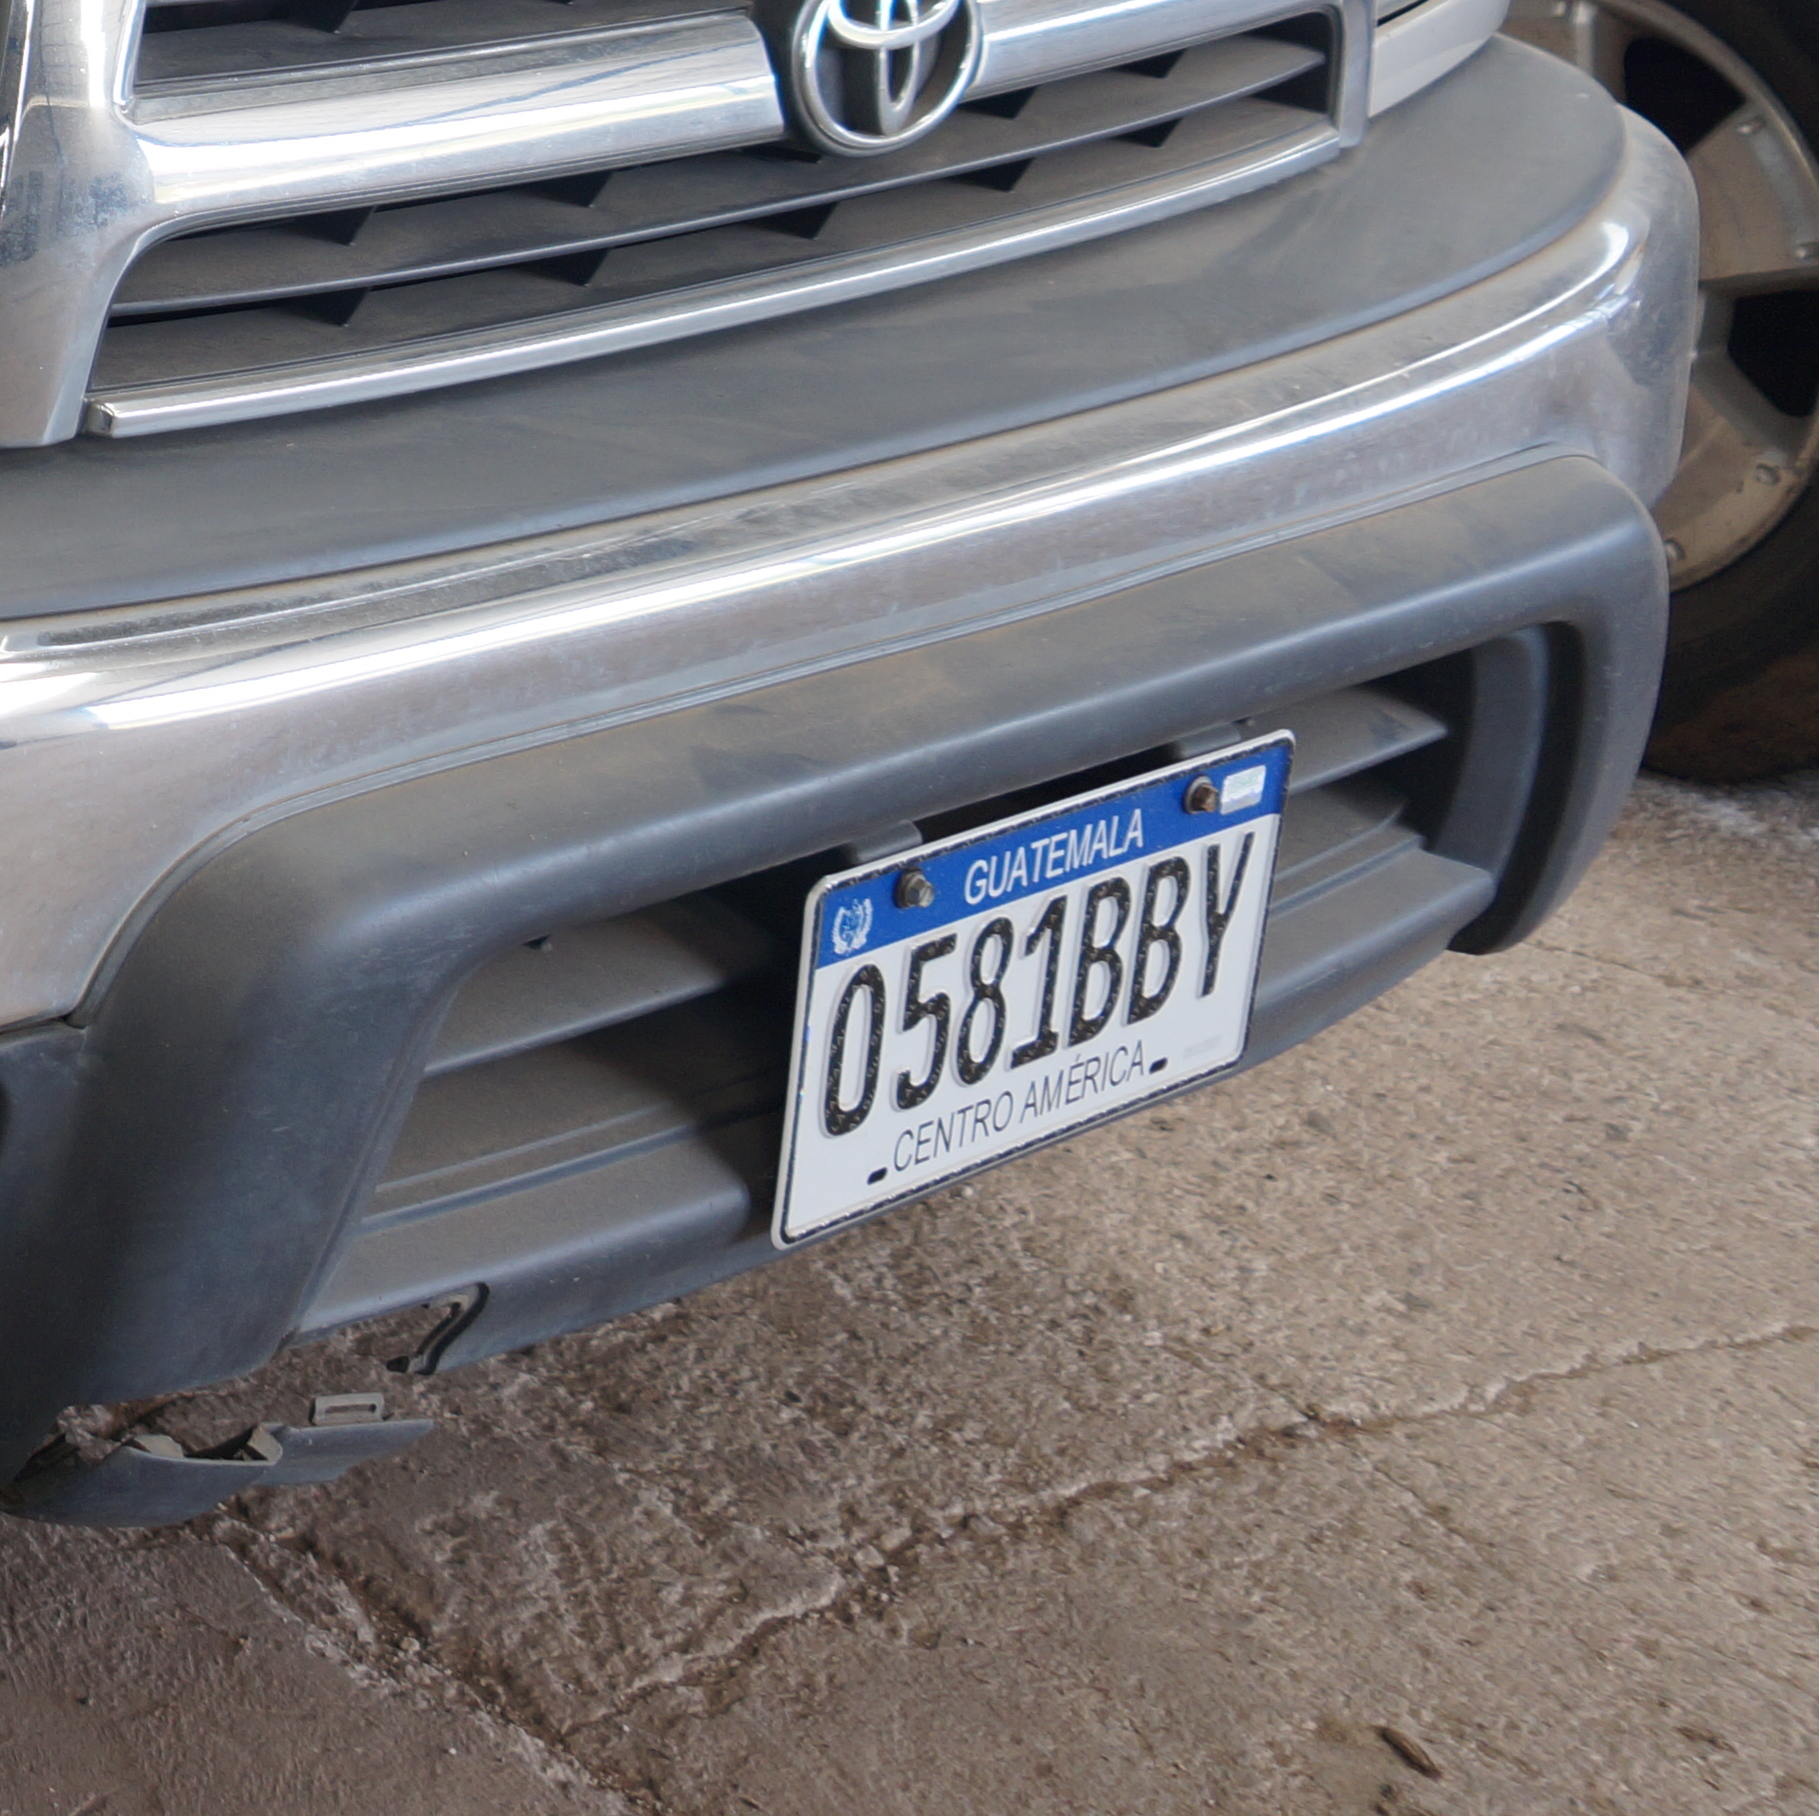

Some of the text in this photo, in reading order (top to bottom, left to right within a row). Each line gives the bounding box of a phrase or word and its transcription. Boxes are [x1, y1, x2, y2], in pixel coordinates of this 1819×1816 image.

[965, 809, 1144, 905] GUATEMALA
[823, 831, 1255, 1137] 0581BBY
[894, 1040, 1146, 1171] CENTRO AMÉRICA
